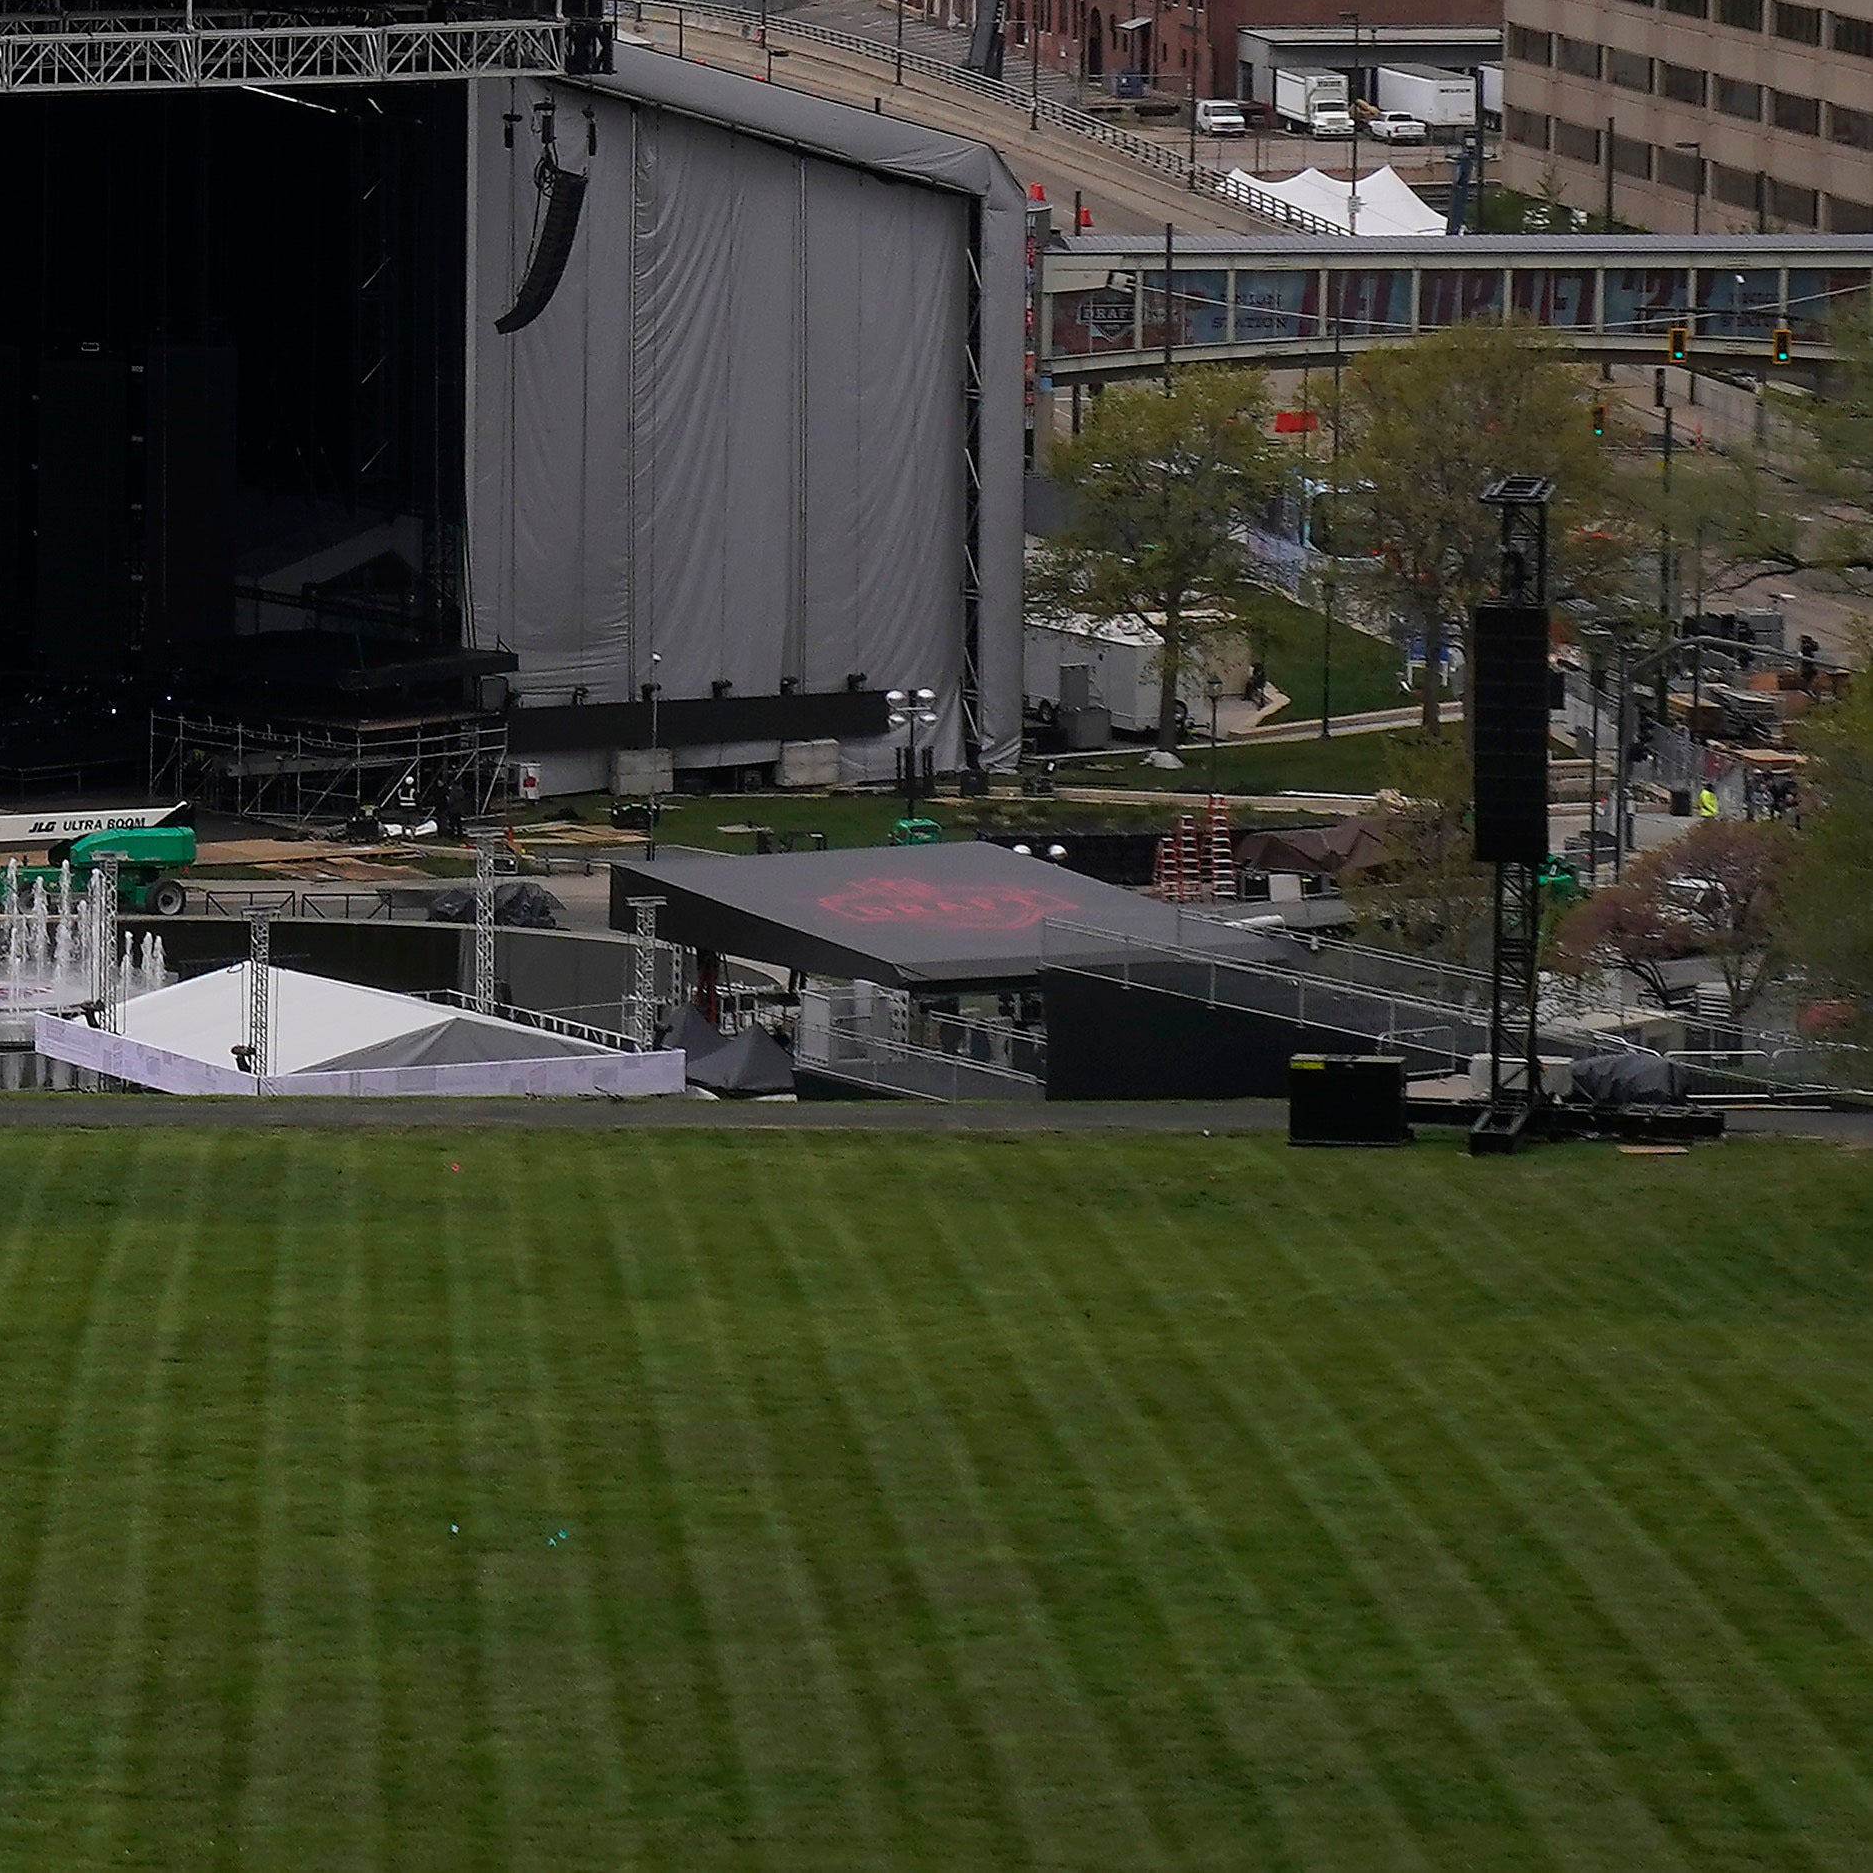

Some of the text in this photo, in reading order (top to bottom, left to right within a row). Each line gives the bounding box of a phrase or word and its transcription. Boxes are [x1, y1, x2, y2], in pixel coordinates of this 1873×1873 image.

[1082, 306, 1133, 321] DRAF
[28, 821, 56, 833] JLG
[63, 818, 103, 832] ULTRA
[106, 816, 146, 830] BOOM
